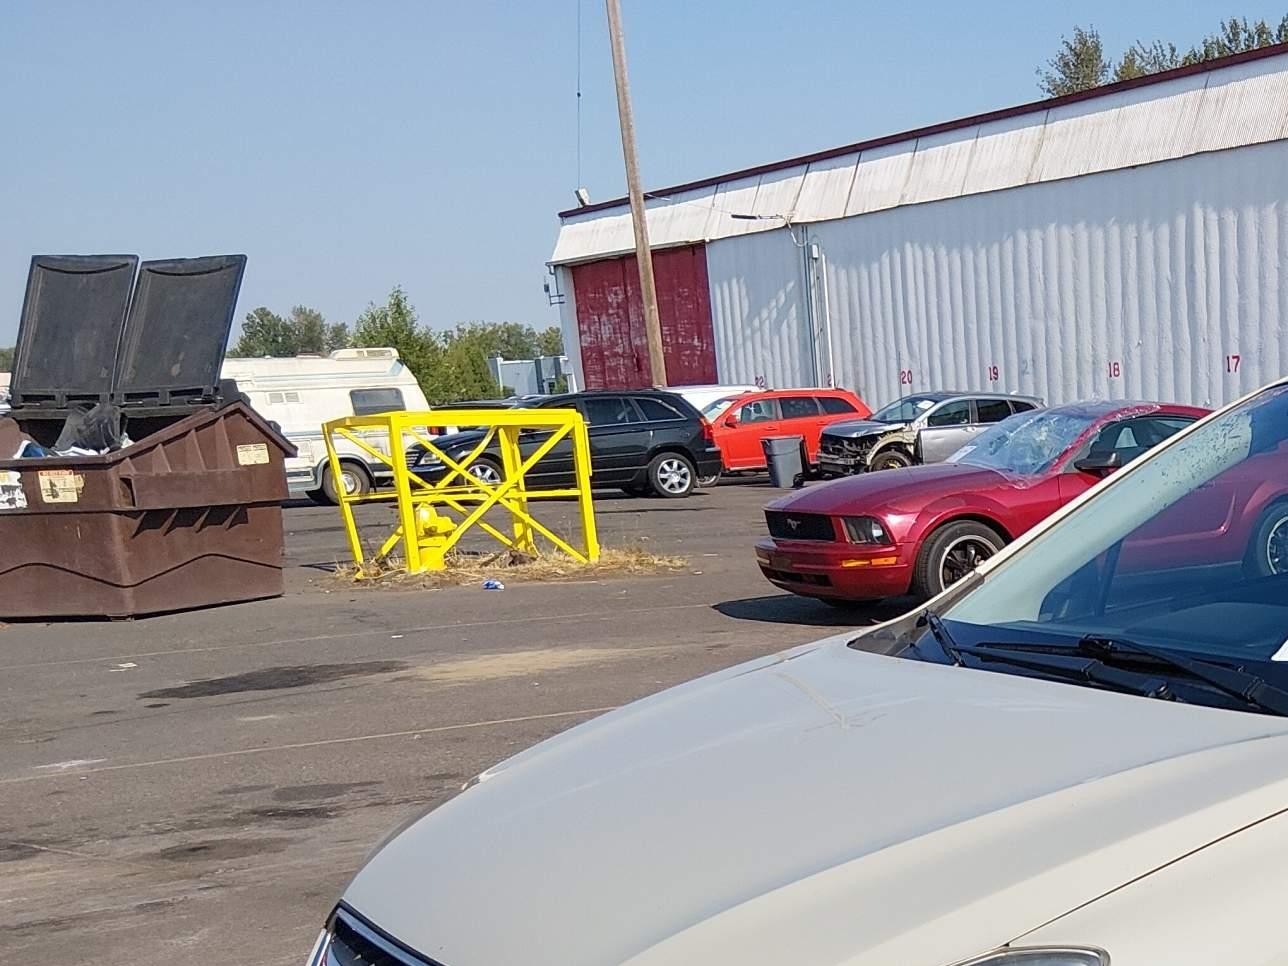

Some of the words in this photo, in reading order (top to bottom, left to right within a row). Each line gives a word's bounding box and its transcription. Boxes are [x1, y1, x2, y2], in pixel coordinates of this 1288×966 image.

[1109, 362, 1120, 378] 18
[1226, 355, 1240, 373] 17
[900, 370, 912, 385] 20
[988, 366, 999, 381] 19
